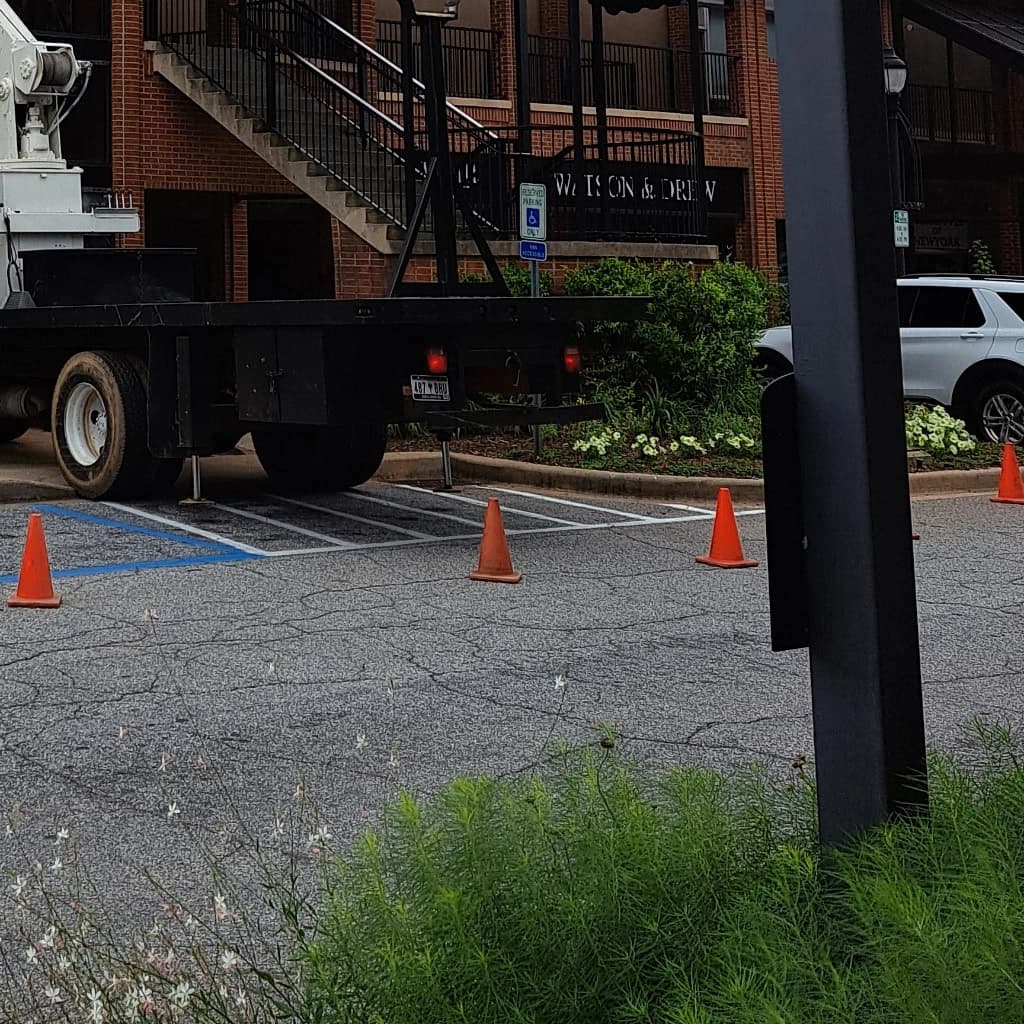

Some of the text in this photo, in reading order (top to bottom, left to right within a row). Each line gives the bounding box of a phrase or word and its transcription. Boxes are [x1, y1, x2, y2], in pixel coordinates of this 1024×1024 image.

[641, 177, 656, 199] &
[522, 198, 543, 206] PARKING
[526, 228, 540, 236] ONLY
